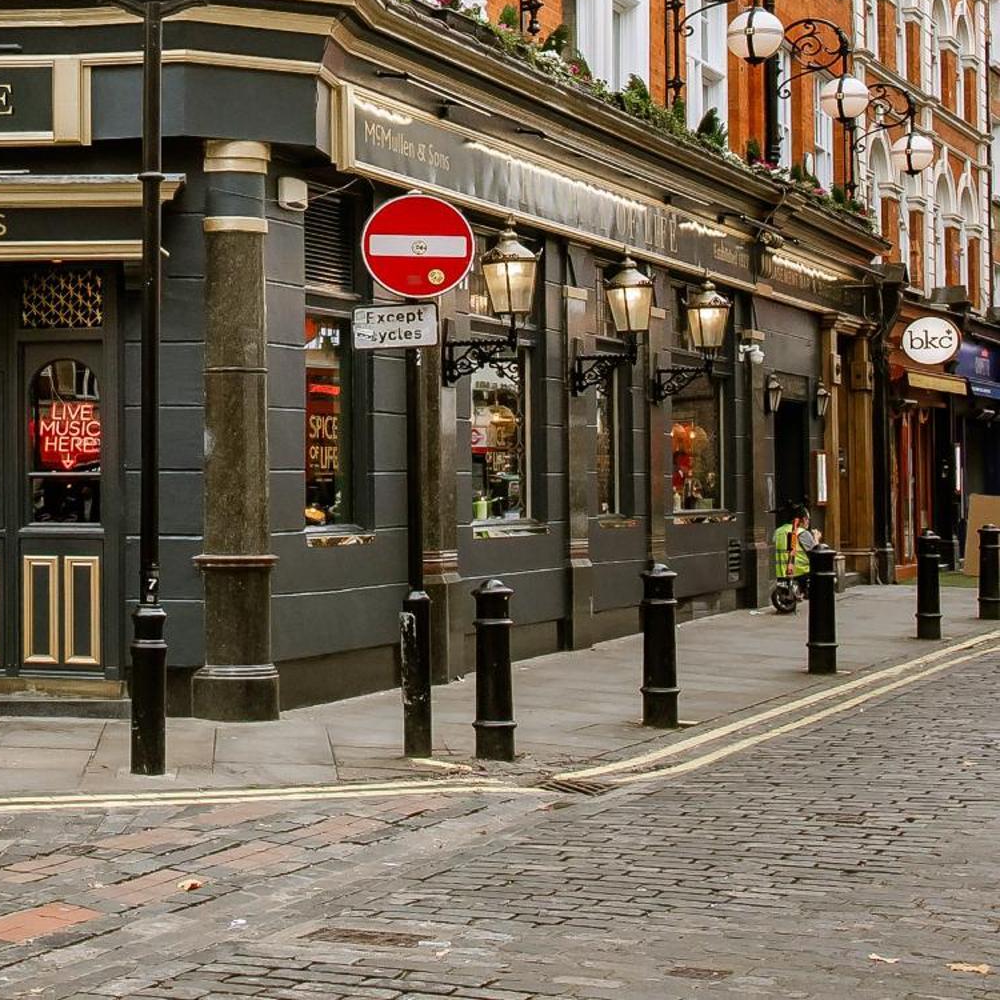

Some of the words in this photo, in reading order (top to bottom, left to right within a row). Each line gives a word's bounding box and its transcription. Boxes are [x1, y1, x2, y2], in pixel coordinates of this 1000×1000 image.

[417, 143, 427, 161] &
[428, 142, 450, 172] Sons
[366, 308, 424, 324] Except
[371, 327, 422, 344] ycles
[907, 329, 953, 350] bkc
[52, 404, 92, 421] LIVE
[39, 420, 101, 437] MUSIC
[308, 415, 338, 440] SPICE
[44, 436, 100, 453] HERE
[148, 578, 158, 590] 7
